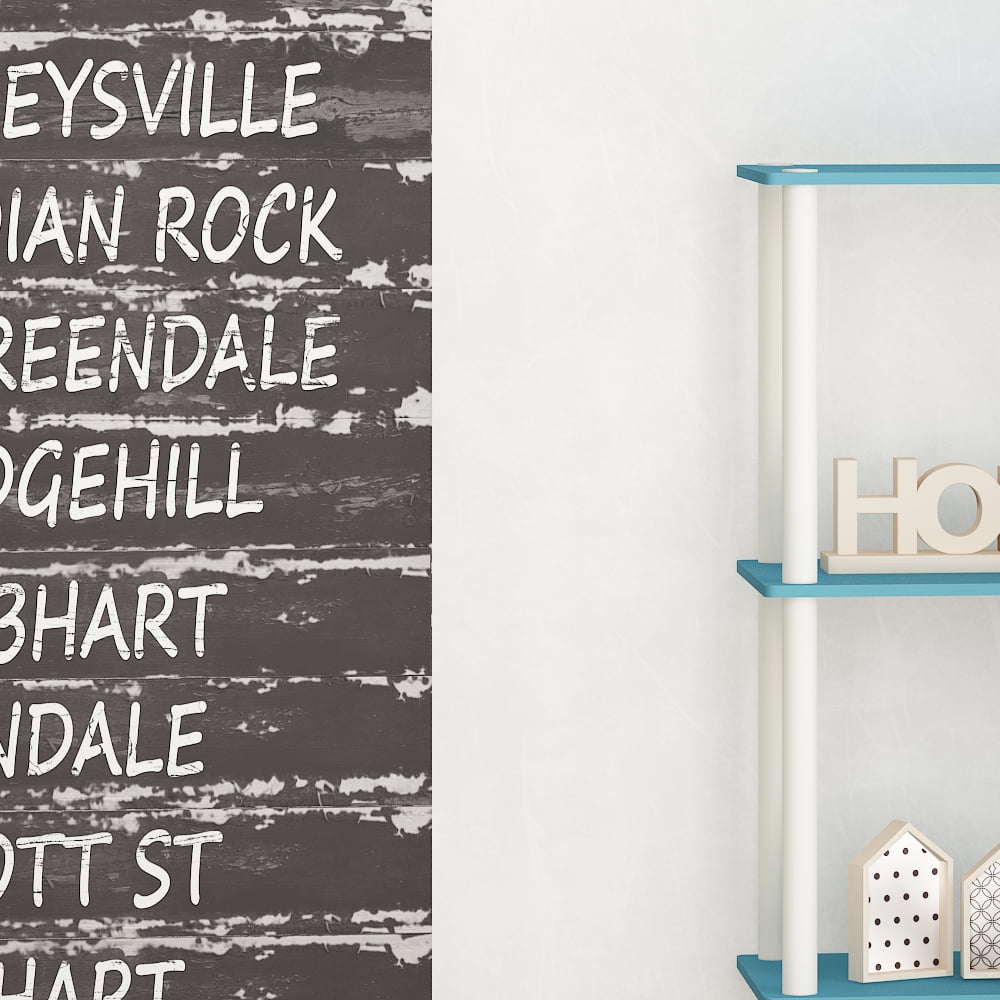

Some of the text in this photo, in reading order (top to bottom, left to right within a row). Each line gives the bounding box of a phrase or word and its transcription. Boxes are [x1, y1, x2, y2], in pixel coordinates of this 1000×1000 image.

[3, 59, 321, 140] EYSVILLE
[0, 182, 343, 264] IAN ROCK
[0, 829, 223, 909] TT ST
